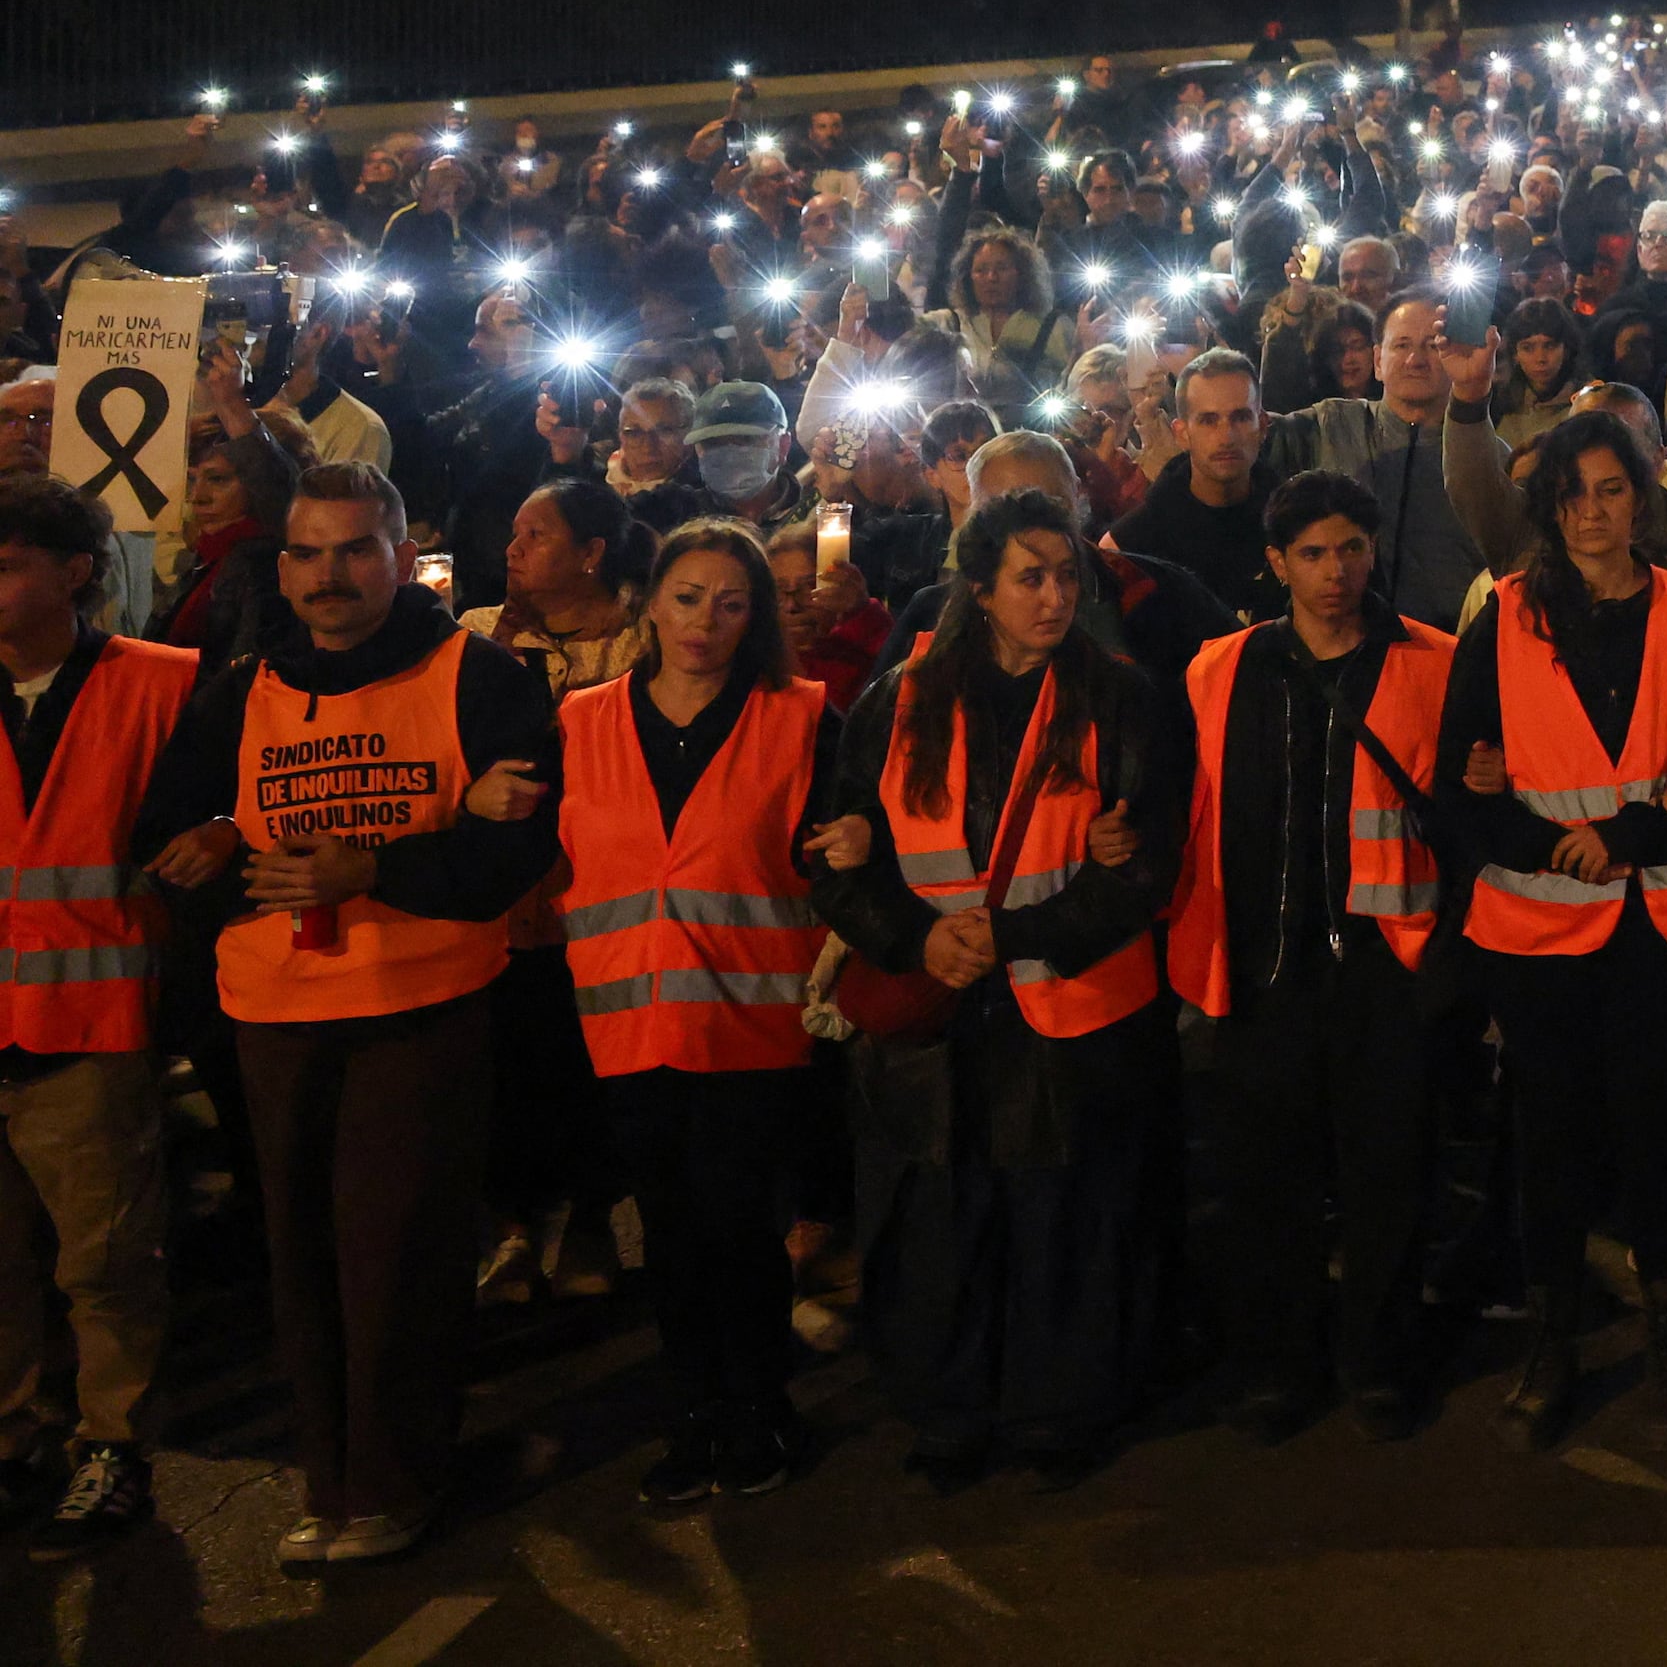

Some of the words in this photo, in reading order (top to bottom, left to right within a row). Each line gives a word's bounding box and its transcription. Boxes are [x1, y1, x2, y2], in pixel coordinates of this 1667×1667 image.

[66, 331, 190, 350] MARICARMEN
[97, 315, 115, 329] NI
[126, 315, 161, 330] UNA
[261, 733, 385, 770] SINDICATO
[260, 779, 288, 808] DE
[290, 766, 430, 802] INQUILINAS
[266, 816, 279, 839] E
[280, 801, 411, 837] INQUILINOS
